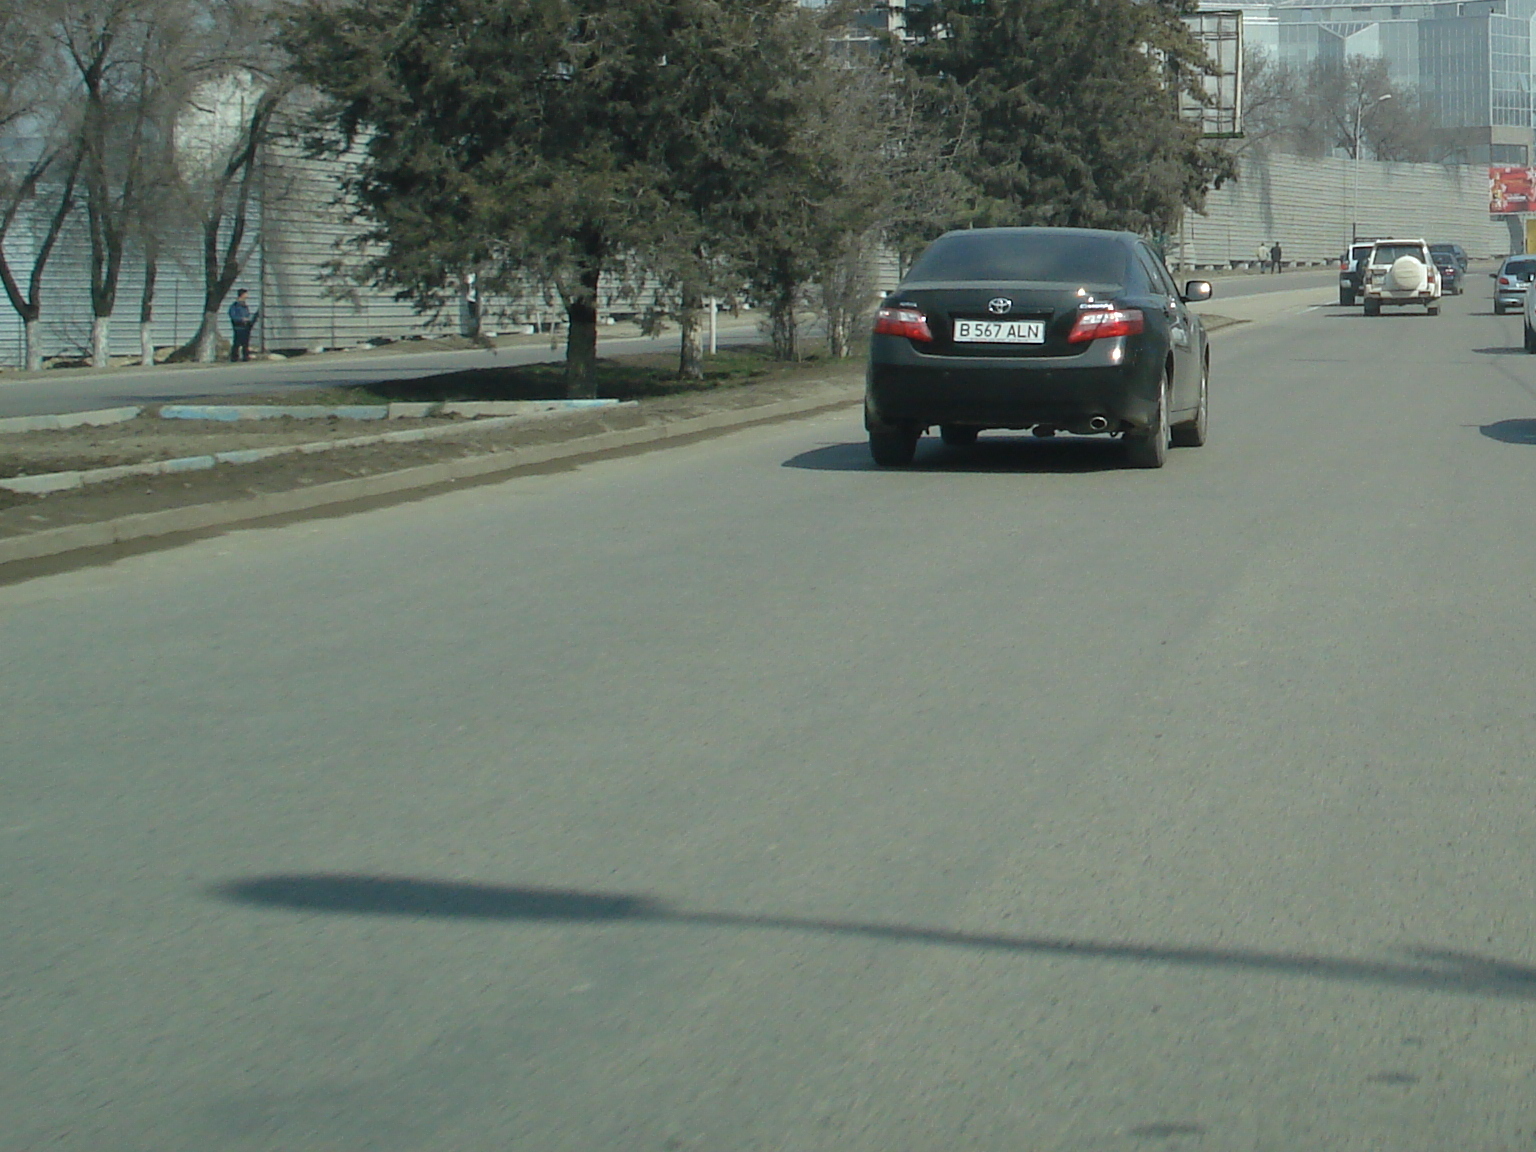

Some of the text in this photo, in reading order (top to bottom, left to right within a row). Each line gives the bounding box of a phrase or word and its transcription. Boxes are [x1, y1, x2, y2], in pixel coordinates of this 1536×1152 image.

[959, 323, 1040, 339] B 567 ALN
